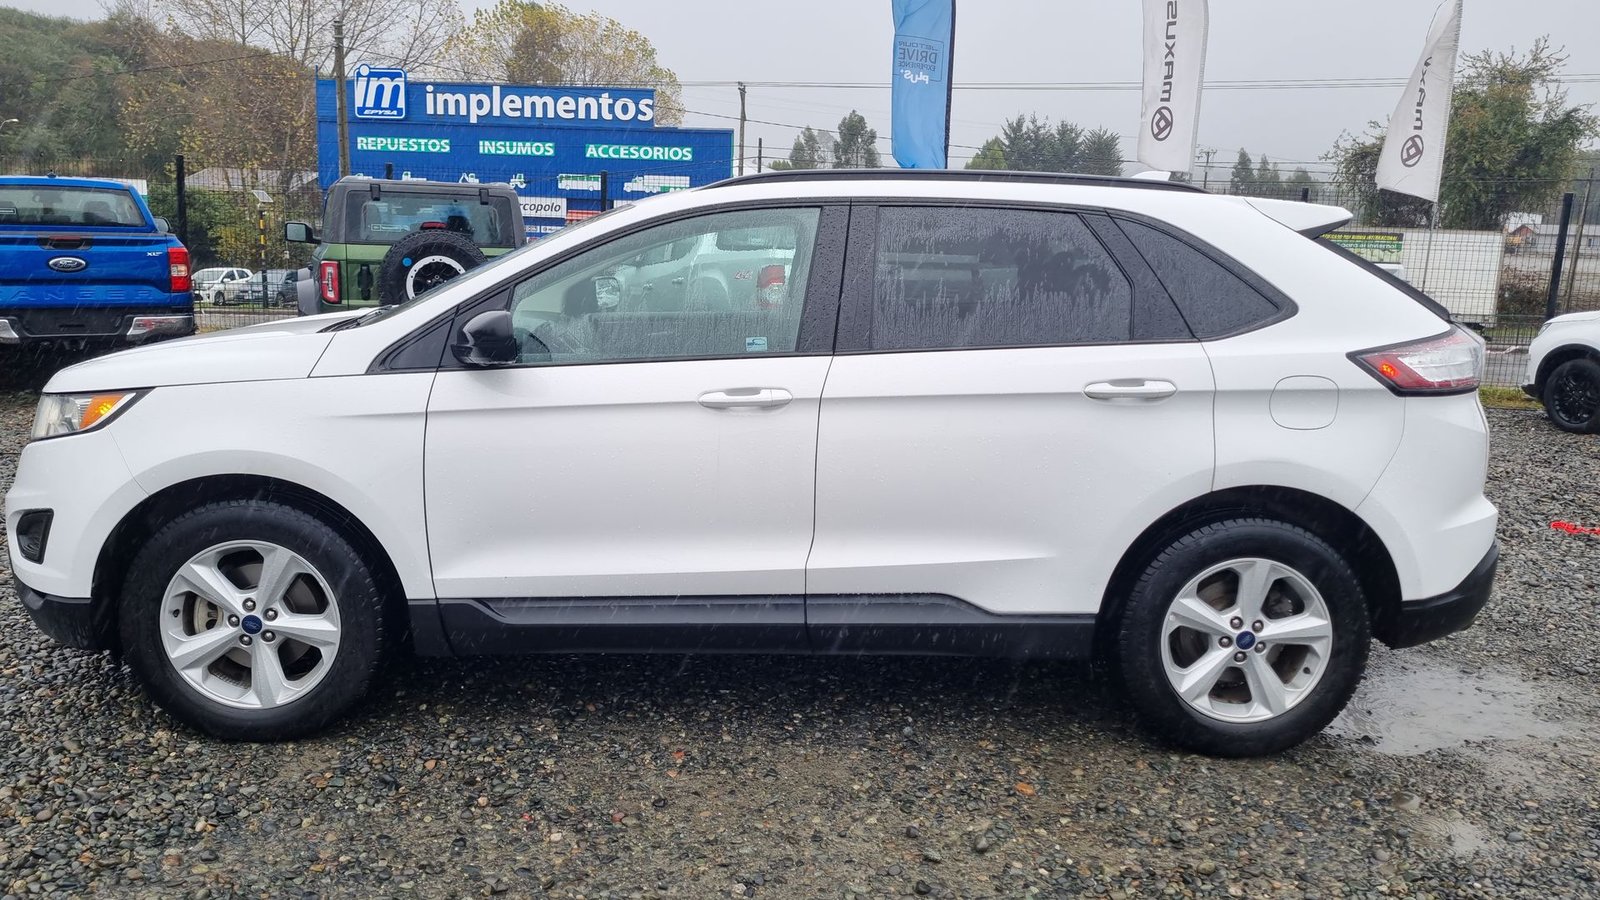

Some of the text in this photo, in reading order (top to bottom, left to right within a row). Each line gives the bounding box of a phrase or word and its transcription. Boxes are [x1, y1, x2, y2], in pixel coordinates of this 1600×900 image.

[425, 85, 654, 123] implementos
[357, 137, 693, 160] REPUESTOS INSUMOS ACCESORIOS
[0, 288, 153, 300] ANGER
